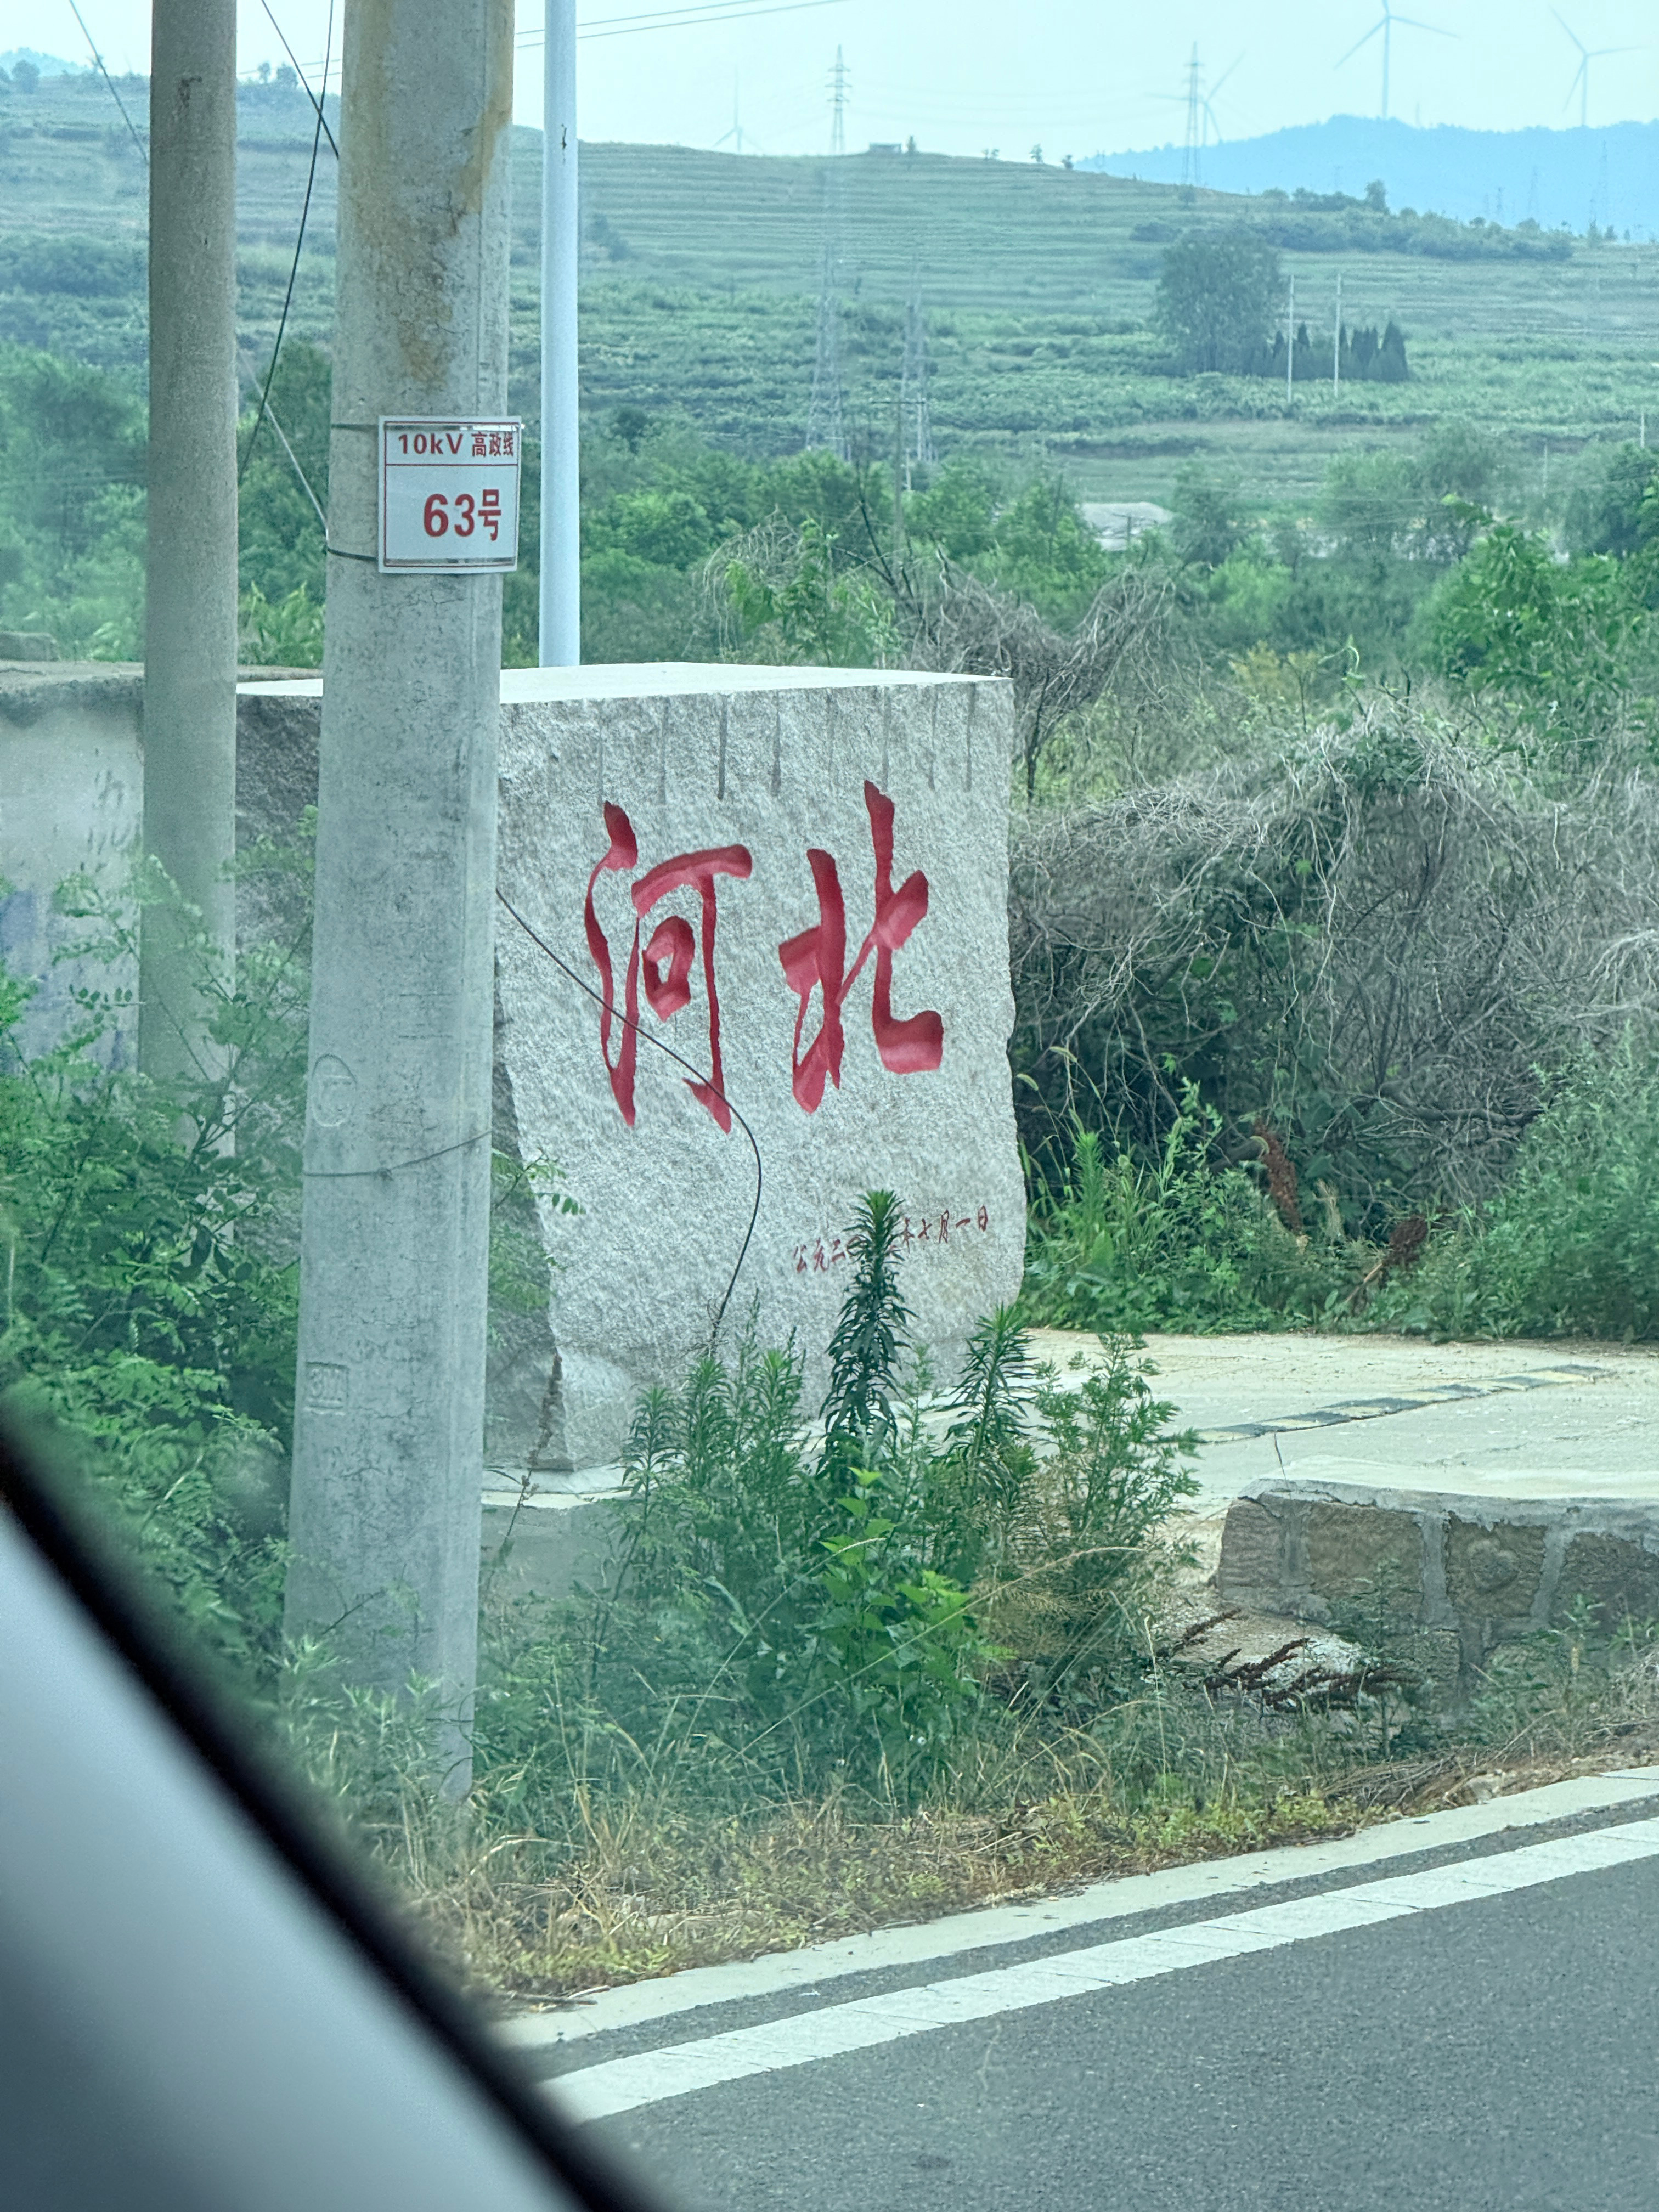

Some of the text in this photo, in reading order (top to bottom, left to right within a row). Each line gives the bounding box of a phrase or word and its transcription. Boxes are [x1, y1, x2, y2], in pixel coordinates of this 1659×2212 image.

[398, 433, 463, 454] 10kV
[423, 489, 501, 541] 63号
[584, 780, 944, 1134] 河北
